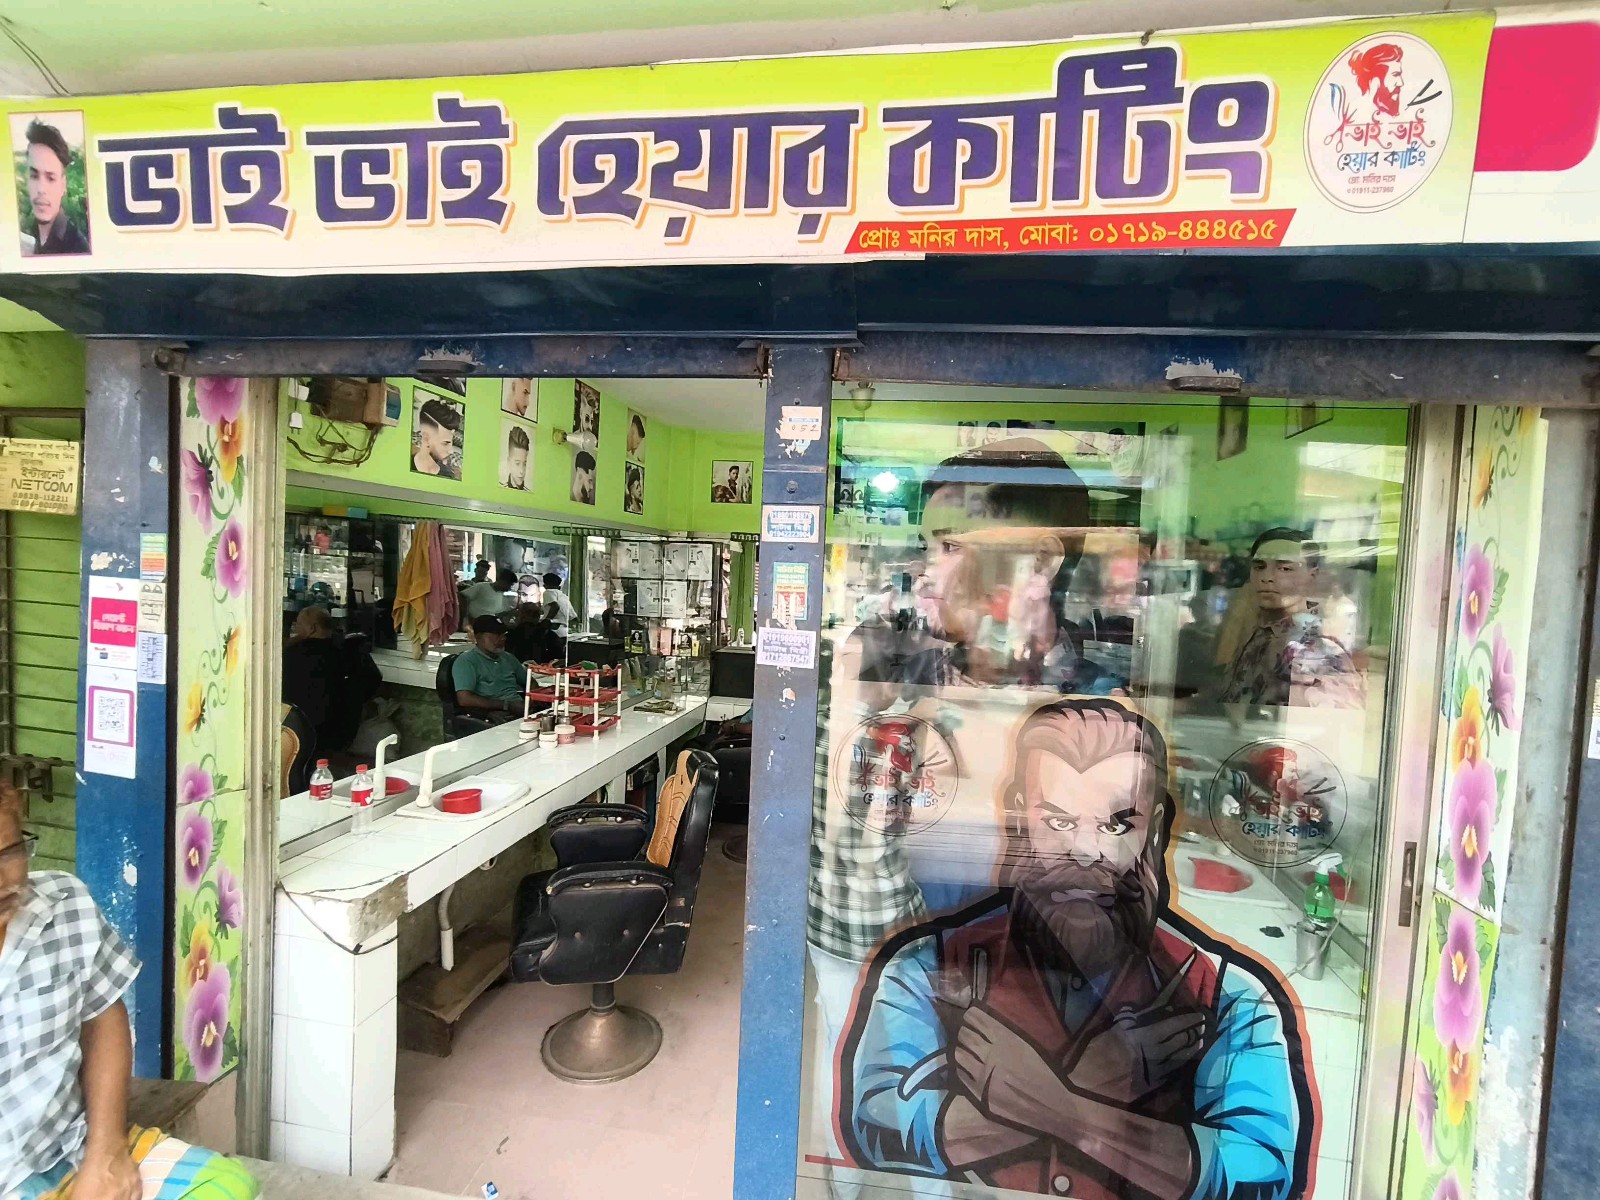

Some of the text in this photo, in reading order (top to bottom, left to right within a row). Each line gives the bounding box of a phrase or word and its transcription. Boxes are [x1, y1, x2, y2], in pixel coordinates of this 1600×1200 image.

[98, 44, 1272, 238] ভাই ভাই হেয়ার কাটিং
[1345, 108, 1436, 150] ভাই ভাই
[1337, 141, 1426, 173] হেয়ার কাটিং
[907, 221, 955, 248] মনির
[965, 225, 1009, 251] দাস,
[1089, 218, 1279, 244] ০১৭১৯-৪৪৪৫১৫
[11, 478, 73, 493] NETCOM
[906, 769, 946, 798] ভাই
